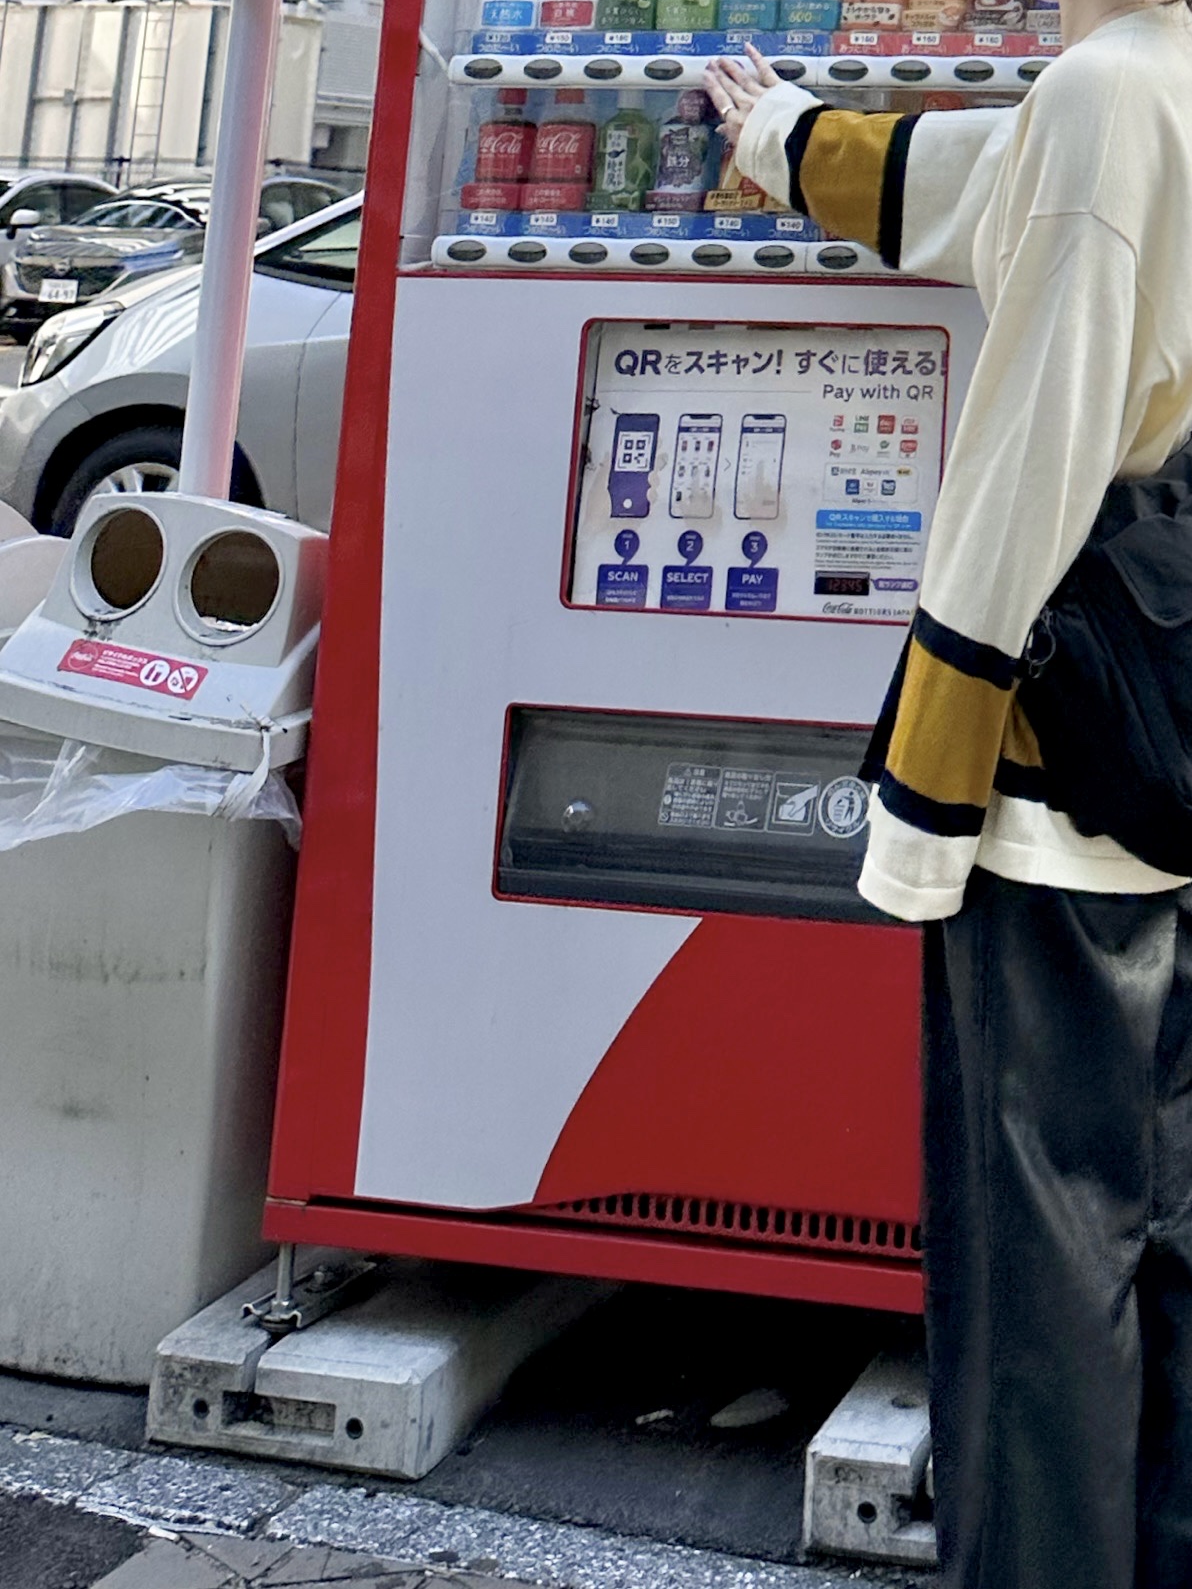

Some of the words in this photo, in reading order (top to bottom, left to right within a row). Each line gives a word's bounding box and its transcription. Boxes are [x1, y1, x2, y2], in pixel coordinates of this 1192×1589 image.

[667, 156, 690, 167] 鉄分
[614, 349, 784, 376] QRをスキャン!
[795, 349, 949, 378] すぐに使える!
[822, 384, 854, 402] Pay
[860, 384, 901, 401] with
[905, 384, 935, 402] QR
[624, 541, 630, 550] 1
[685, 541, 694, 551] 2
[750, 542, 759, 552] 3
[607, 571, 638, 582] SCAN
[666, 572, 709, 583] SELECT
[742, 574, 763, 584] PAY
